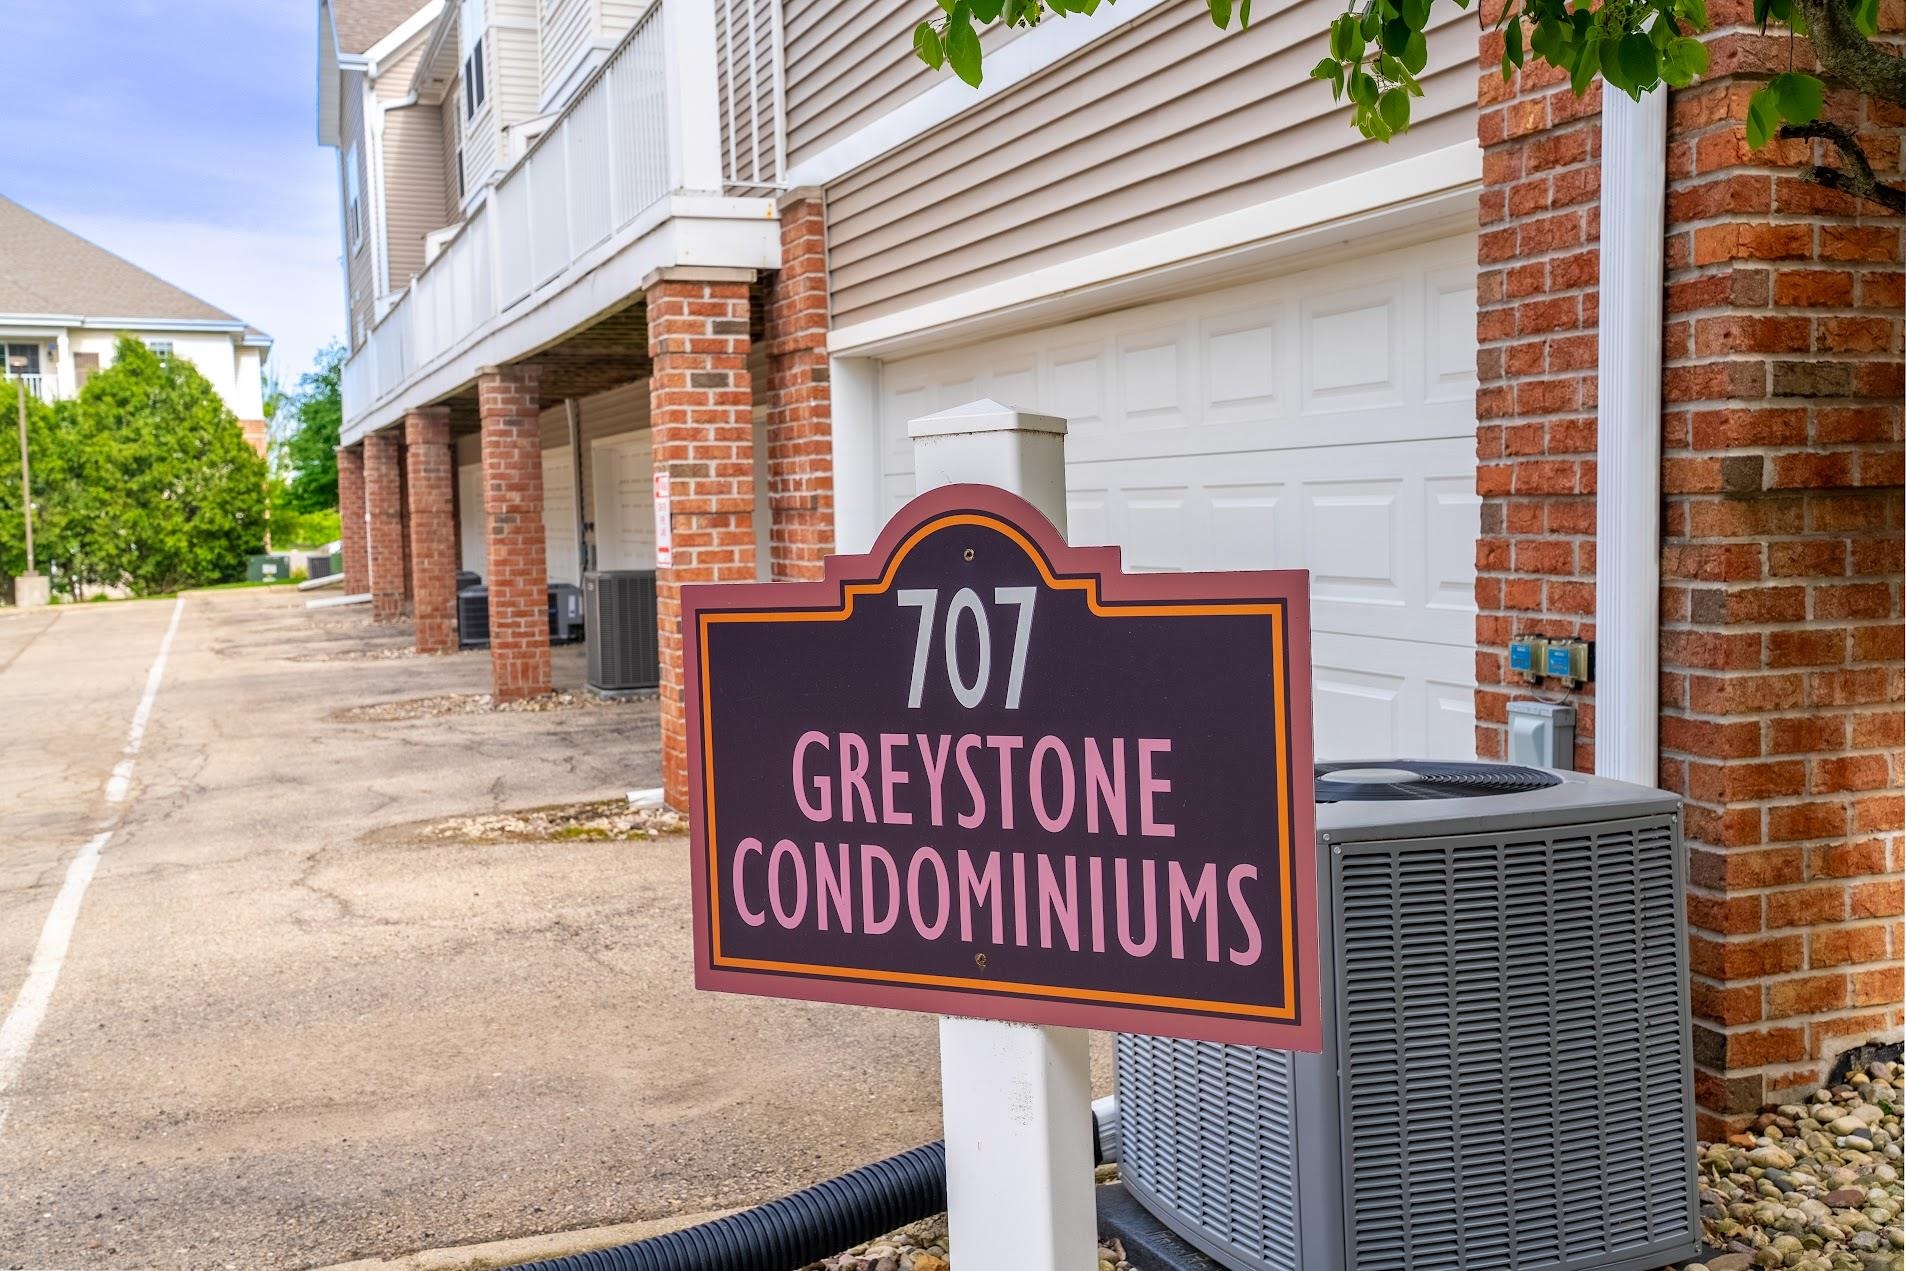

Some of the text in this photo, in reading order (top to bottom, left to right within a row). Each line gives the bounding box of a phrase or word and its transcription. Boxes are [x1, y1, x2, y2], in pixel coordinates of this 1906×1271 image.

[896, 587, 1037, 709] 707
[792, 731, 1175, 837] GREYSTONE
[733, 838, 1262, 966] CONDOMINIUMS
